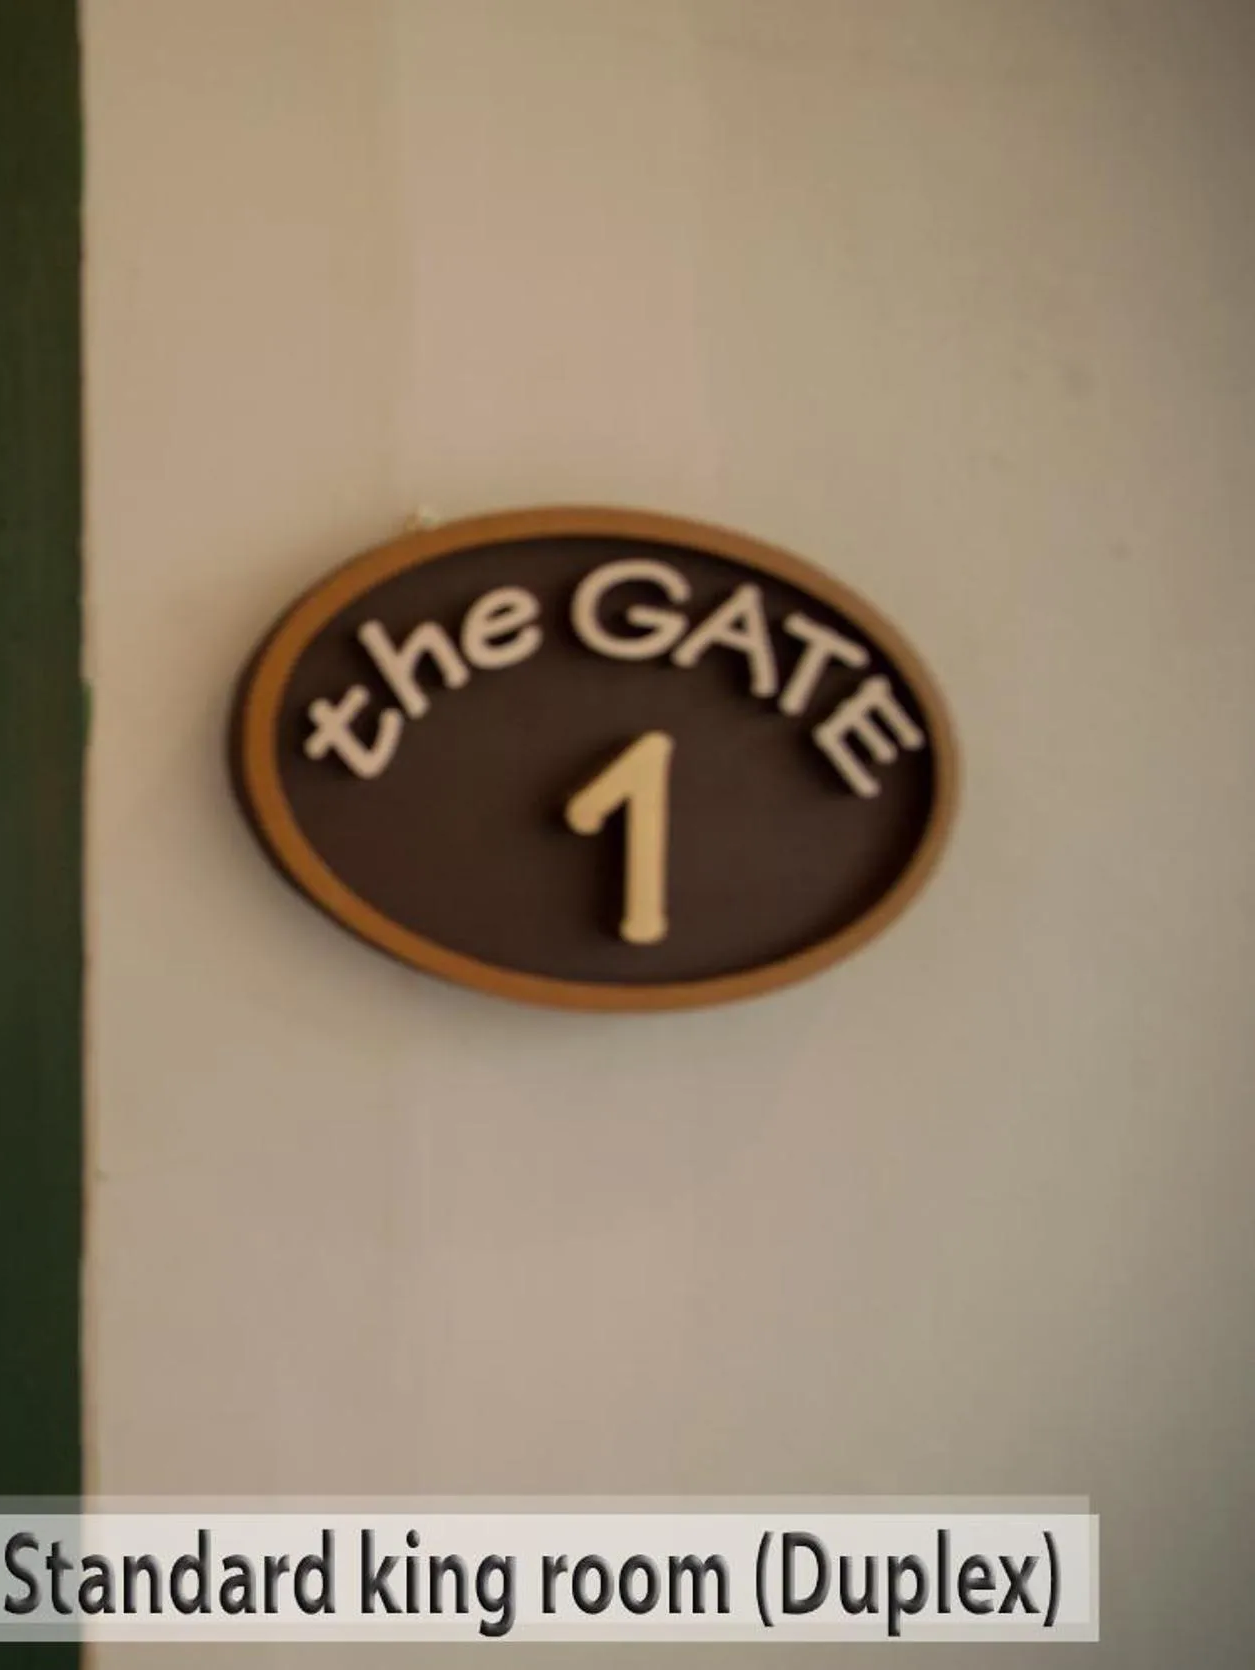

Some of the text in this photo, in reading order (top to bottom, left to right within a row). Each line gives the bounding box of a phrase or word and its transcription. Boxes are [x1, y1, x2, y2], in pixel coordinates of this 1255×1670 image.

[305, 559, 925, 798] the GATE
[565, 731, 673, 944] 1
